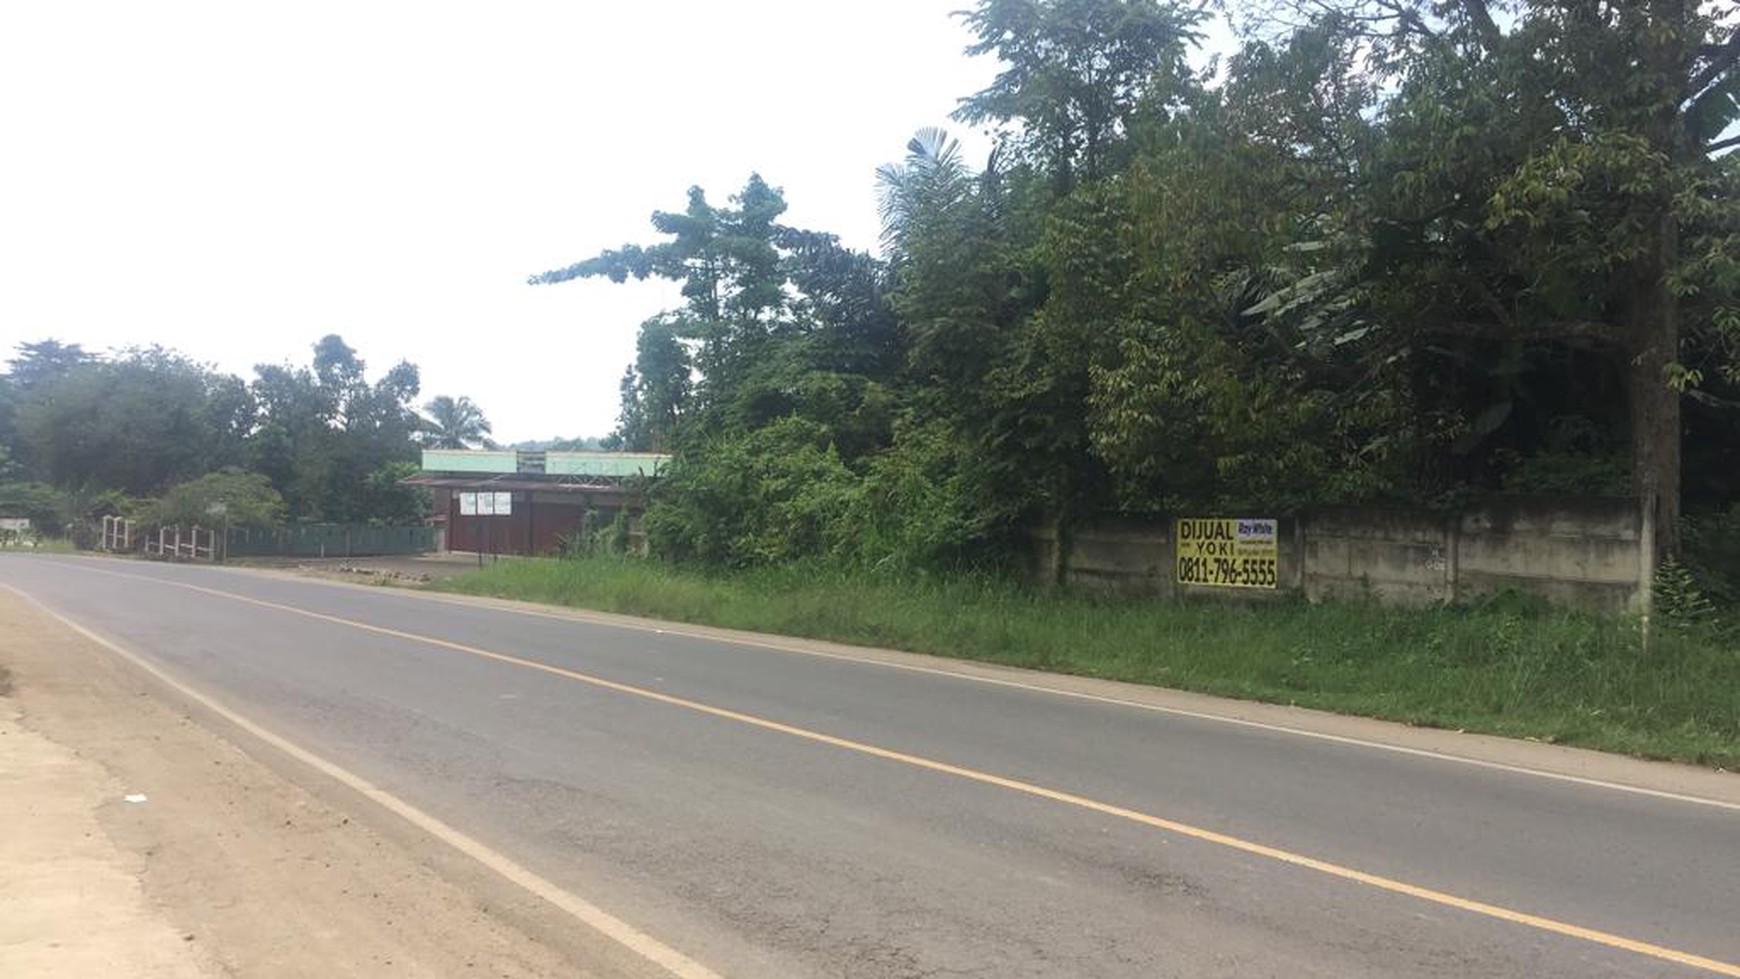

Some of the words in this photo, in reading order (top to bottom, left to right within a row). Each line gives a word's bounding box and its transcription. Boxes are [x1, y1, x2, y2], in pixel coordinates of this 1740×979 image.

[1181, 521, 1234, 540] DIJUAL
[1196, 541, 1235, 556] YOKI
[1179, 557, 1276, 586] 0811-796-5555
